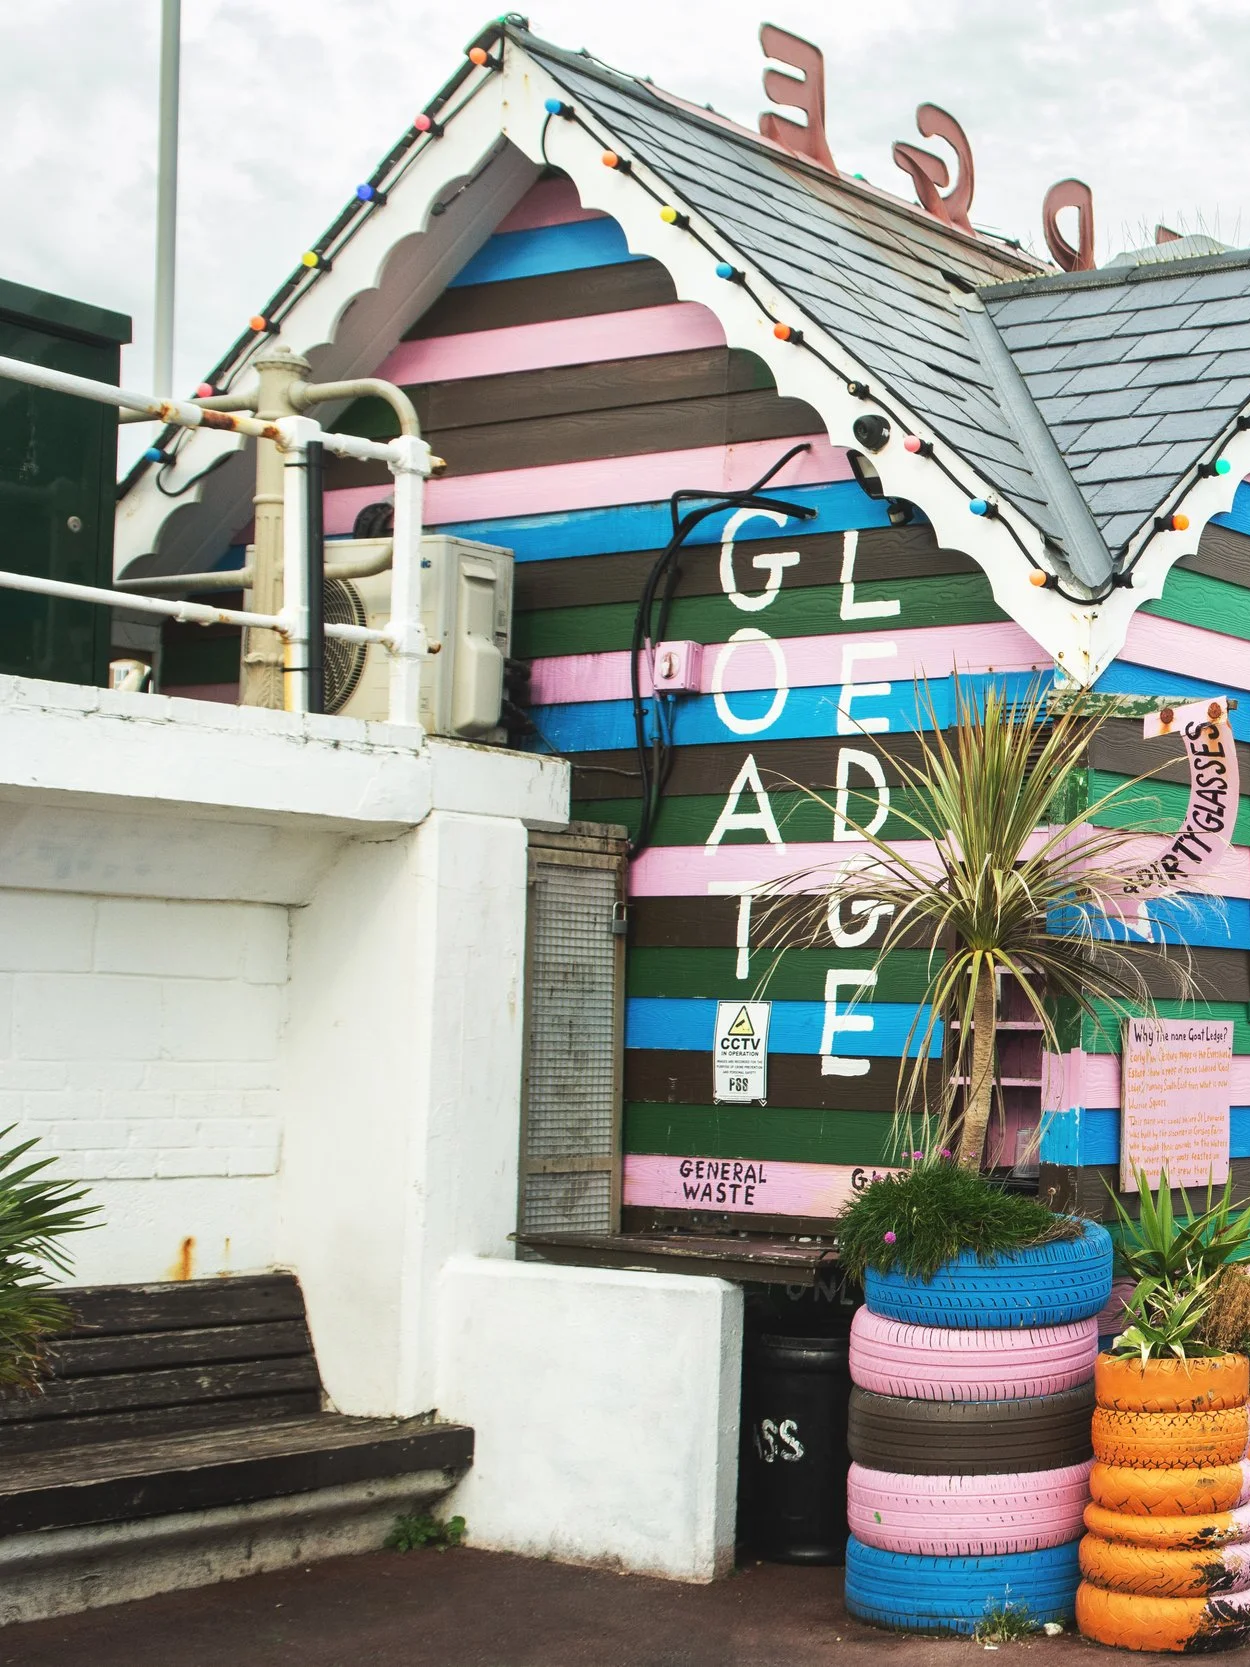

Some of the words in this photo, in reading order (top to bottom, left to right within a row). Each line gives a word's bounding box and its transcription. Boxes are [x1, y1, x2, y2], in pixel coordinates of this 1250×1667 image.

[704, 508, 799, 979] GOAT
[1185, 721, 1228, 834] GLASSES
[819, 531, 900, 1076] LEDGE
[721, 1037, 760, 1050] CCTV
[1134, 1024, 1154, 1046] Why
[1189, 1028, 1205, 1042] Goat
[1206, 1027, 1228, 1043] Ledge?
[680, 1160, 767, 1184] GENERAL
[683, 1182, 755, 1205] WASTE
